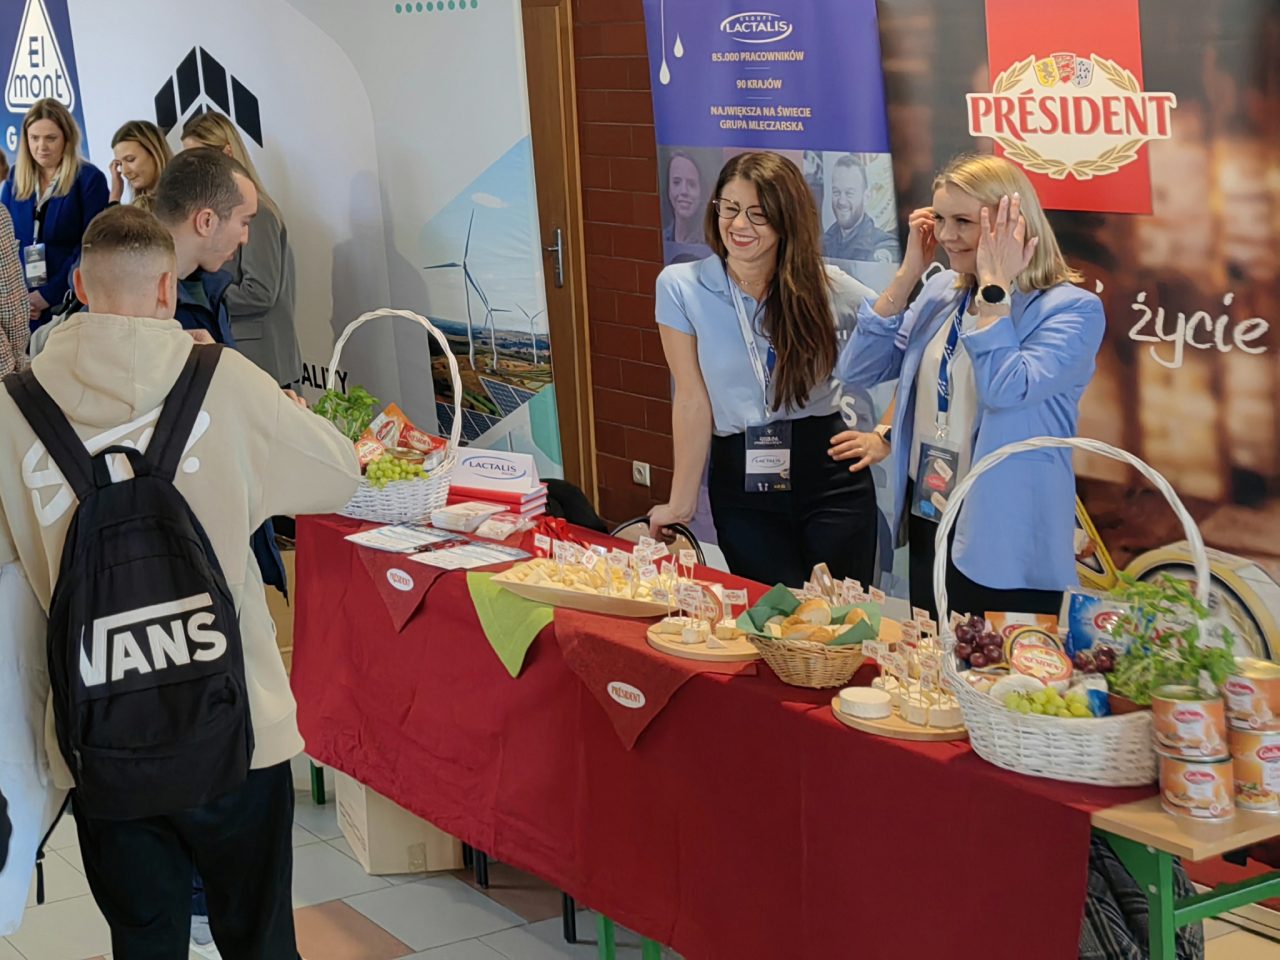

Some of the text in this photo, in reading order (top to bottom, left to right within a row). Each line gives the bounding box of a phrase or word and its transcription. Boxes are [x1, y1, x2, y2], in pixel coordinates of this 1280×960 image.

[726, 21, 788, 32] LACTALIS
[28, 36, 45, 67] El
[712, 50, 804, 62] 85.000 PRACOWNIKÓW
[14, 69, 63, 98] mont
[736, 77, 782, 89] 90 KRAJÓW
[711, 105, 812, 118] NAJWIĘKSZA NA ŚWIECIE
[970, 88, 1174, 141] PRÉSIDENT
[720, 120, 804, 131] GRUPA MLECZARSKA
[1128, 292, 1269, 369] życie
[280, 362, 348, 395] ALIY
[469, 461, 517, 472] LACTALIS
[79, 592, 227, 687] VANS
